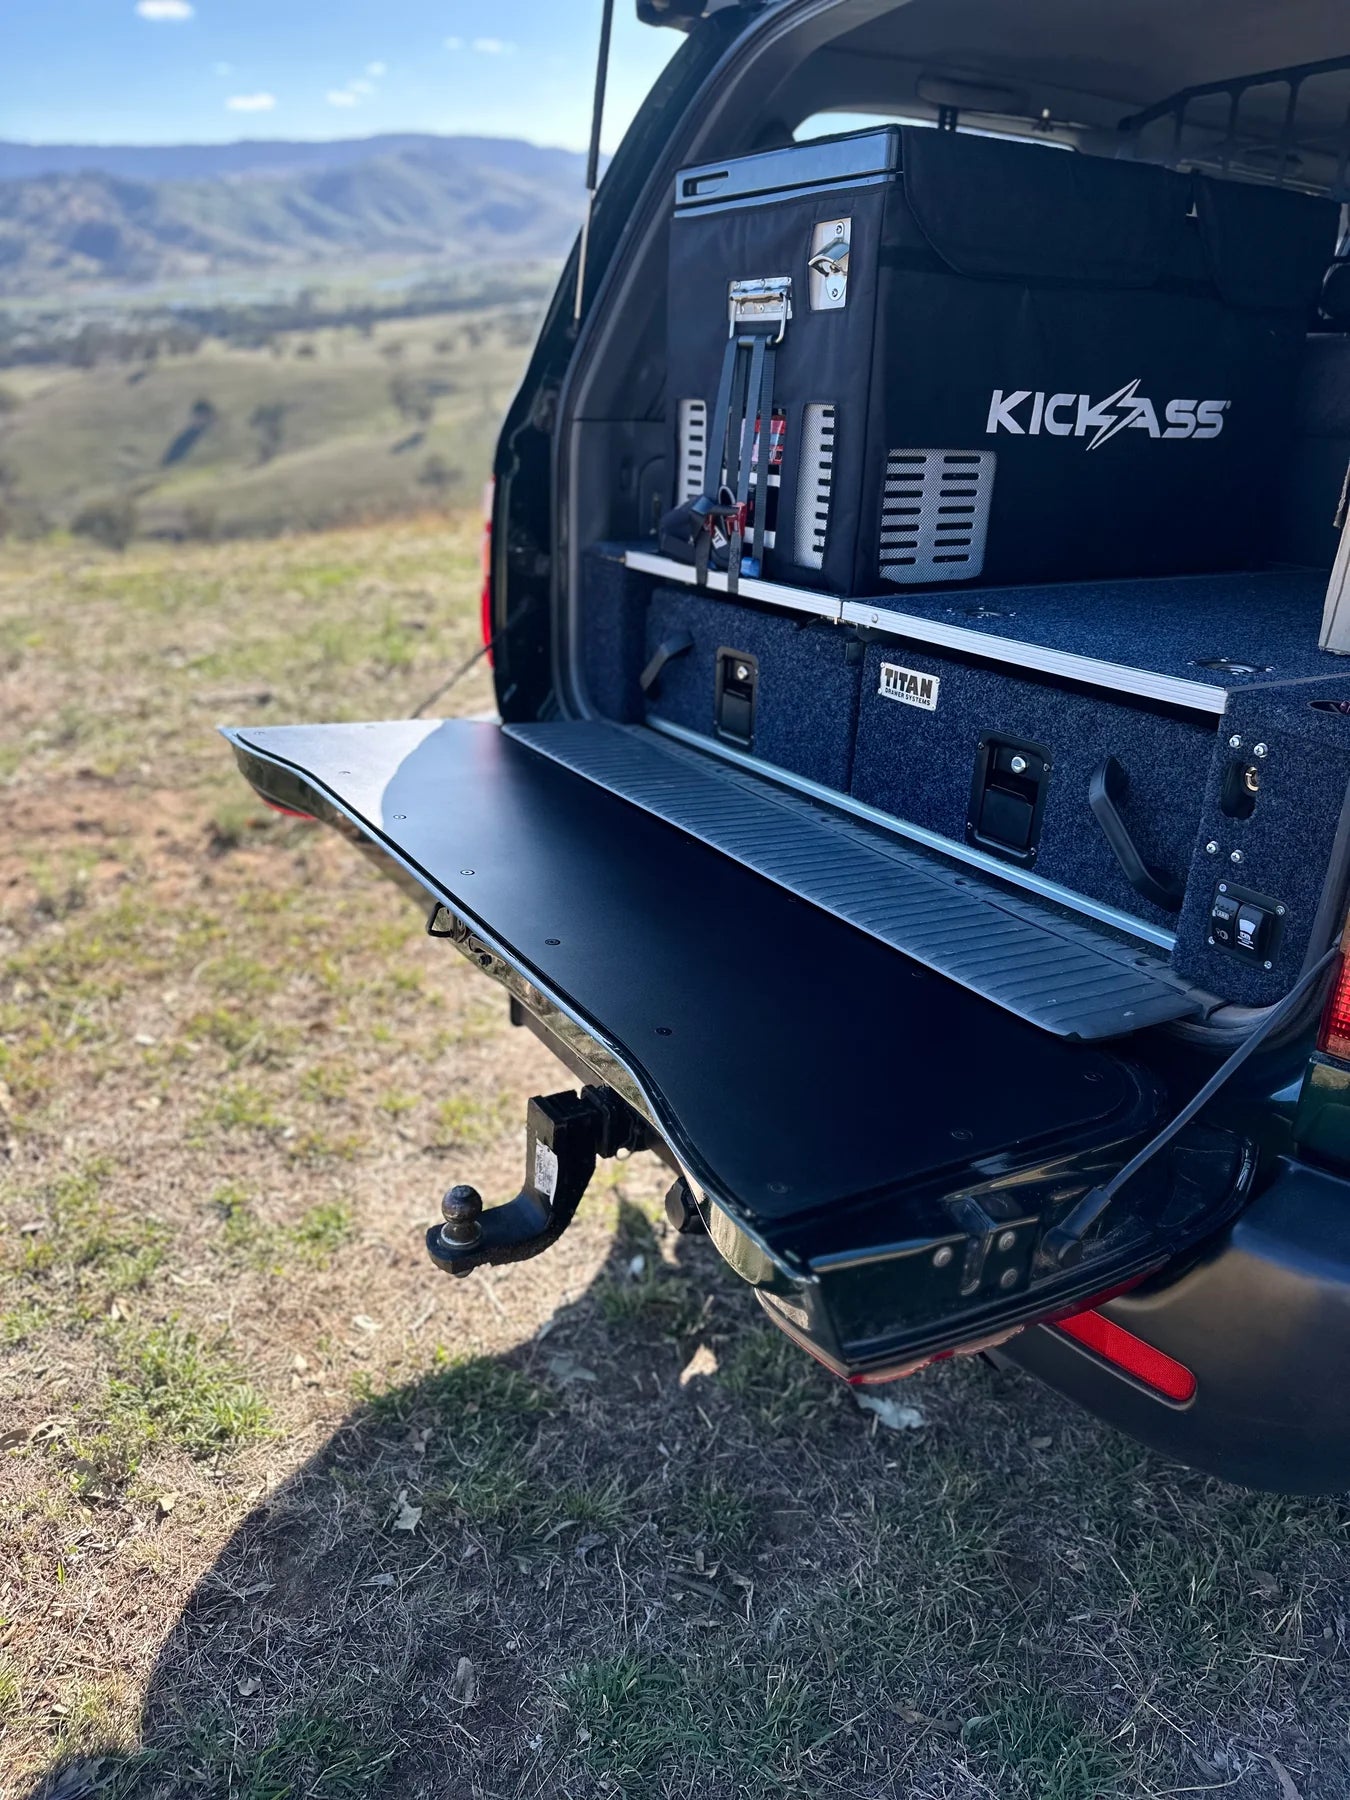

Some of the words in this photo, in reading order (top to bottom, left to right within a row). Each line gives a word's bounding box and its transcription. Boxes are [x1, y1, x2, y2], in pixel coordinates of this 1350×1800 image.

[986, 379, 1226, 450] KICKASS
[885, 667, 933, 699] TITAN
[885, 687, 905, 698] DRAWER
[905, 693, 931, 706] SYSTEMS
